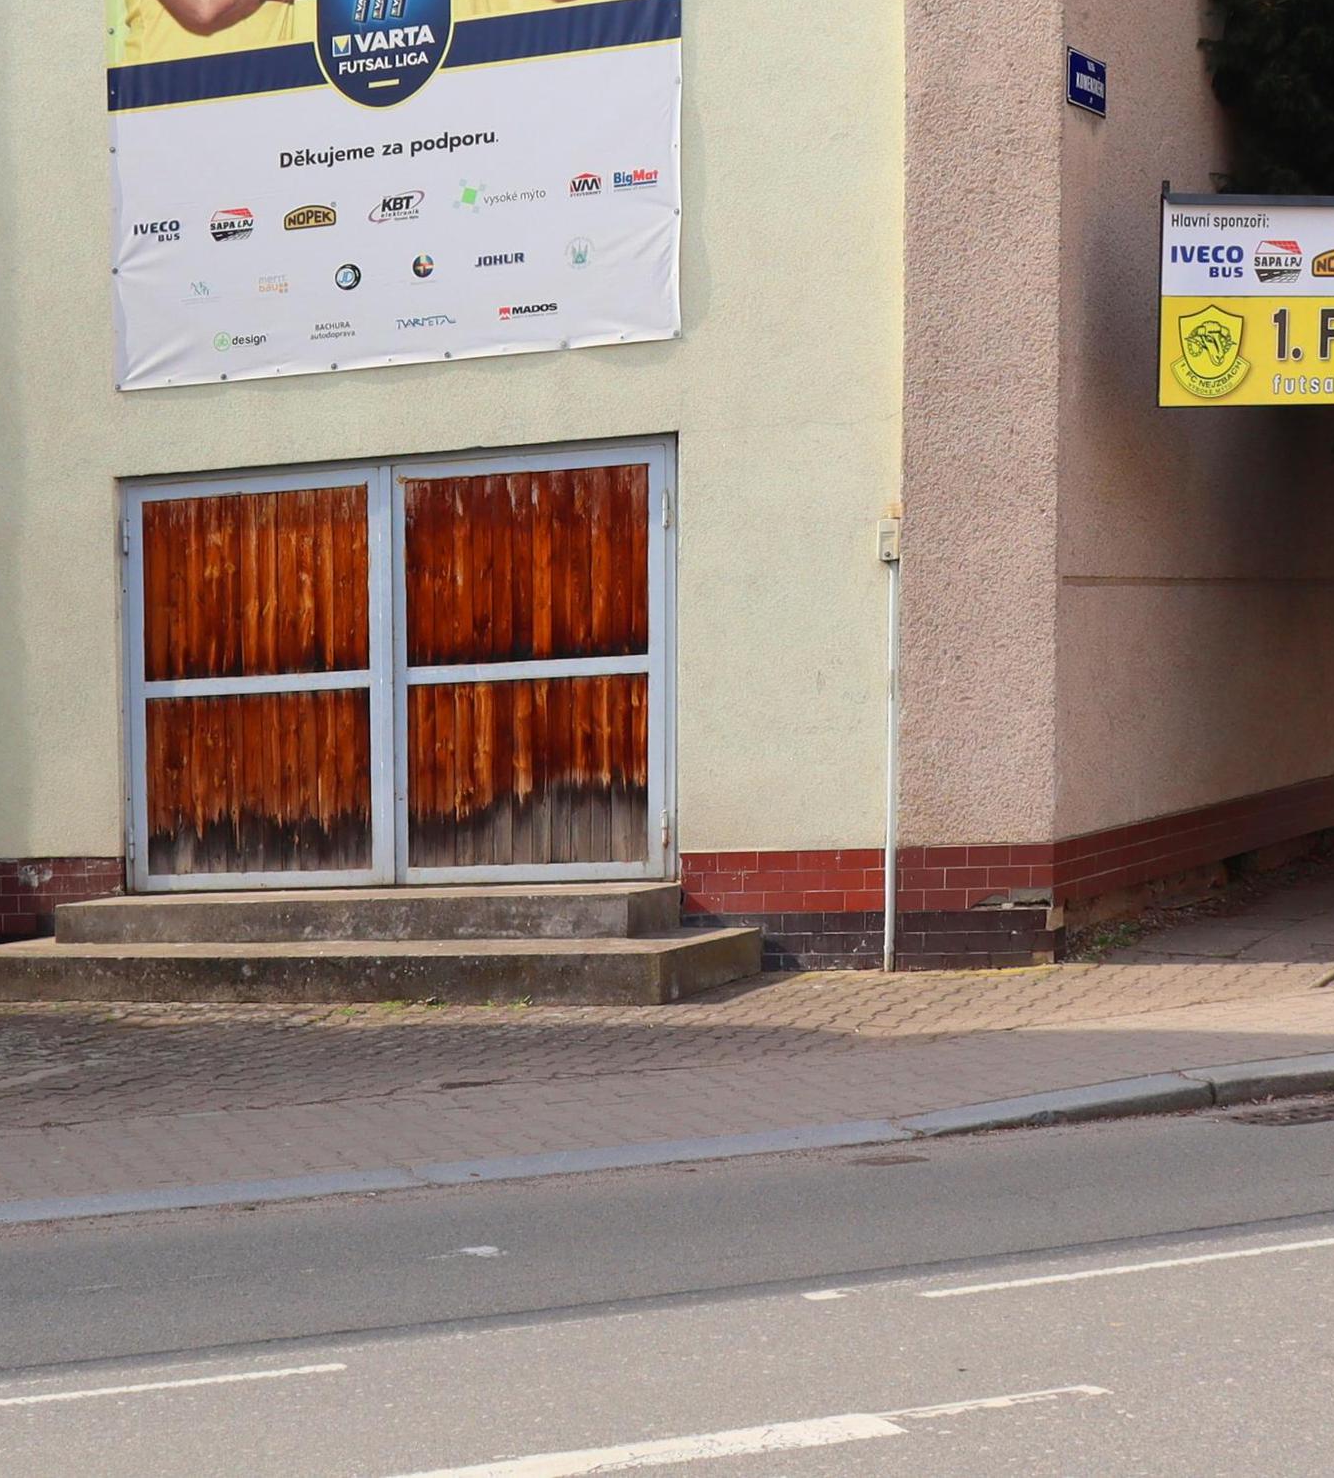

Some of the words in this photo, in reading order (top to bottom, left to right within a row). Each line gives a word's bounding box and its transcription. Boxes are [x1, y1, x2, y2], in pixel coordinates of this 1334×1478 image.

[354, 25, 435, 53] VARTA
[339, 56, 392, 75] FUTSAL
[395, 52, 428, 67] LIGA
[279, 146, 375, 168] Děkujeme
[382, 143, 403, 156] za
[410, 131, 499, 158] podporu.
[613, 169, 658, 186] BigMat
[381, 195, 414, 212] KBT
[483, 191, 518, 205] vysoké
[520, 189, 546, 202] mýto
[210, 221, 235, 231] SAPA
[288, 210, 333, 227] NOPEK
[1171, 213, 1210, 228] Hlavní
[1213, 214, 1269, 230] sponzoři:
[133, 220, 180, 236] IVECO
[157, 233, 180, 242] BUS
[475, 252, 524, 268] JOHUR
[1170, 245, 1244, 263] IVECO
[1254, 257, 1282, 267] SAPA
[1209, 267, 1244, 278] BUS
[512, 303, 558, 315] MADOS
[314, 321, 351, 331] BACHURA
[1272, 307, 1303, 361] 1.
[232, 334, 267, 346] design
